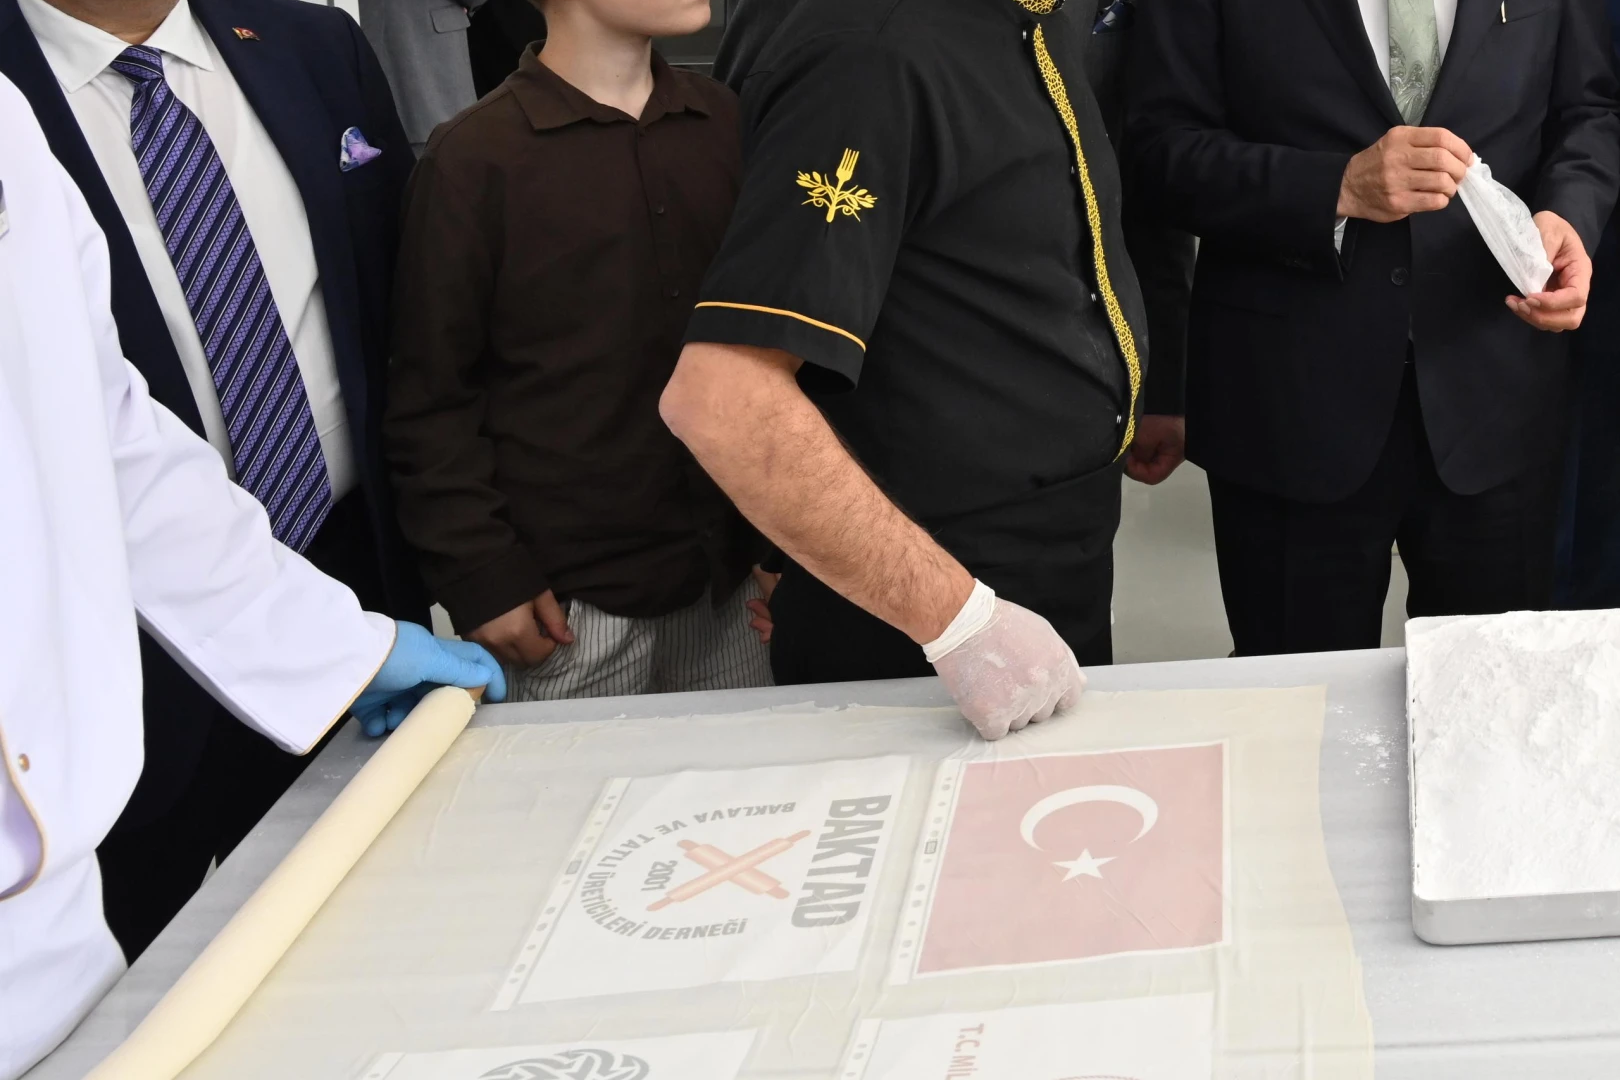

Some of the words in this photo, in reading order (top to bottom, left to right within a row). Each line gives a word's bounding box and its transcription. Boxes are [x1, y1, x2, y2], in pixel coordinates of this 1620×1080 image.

[654, 819, 688, 836] VE
[693, 801, 796, 824] BAKLAVA
[597, 833, 656, 868] TATLI
[791, 794, 892, 929] BAKTAD
[641, 860, 678, 892] 2001
[580, 871, 648, 937] ÜRETİCİLERİ
[640, 918, 748, 941] DERNEĞİ
